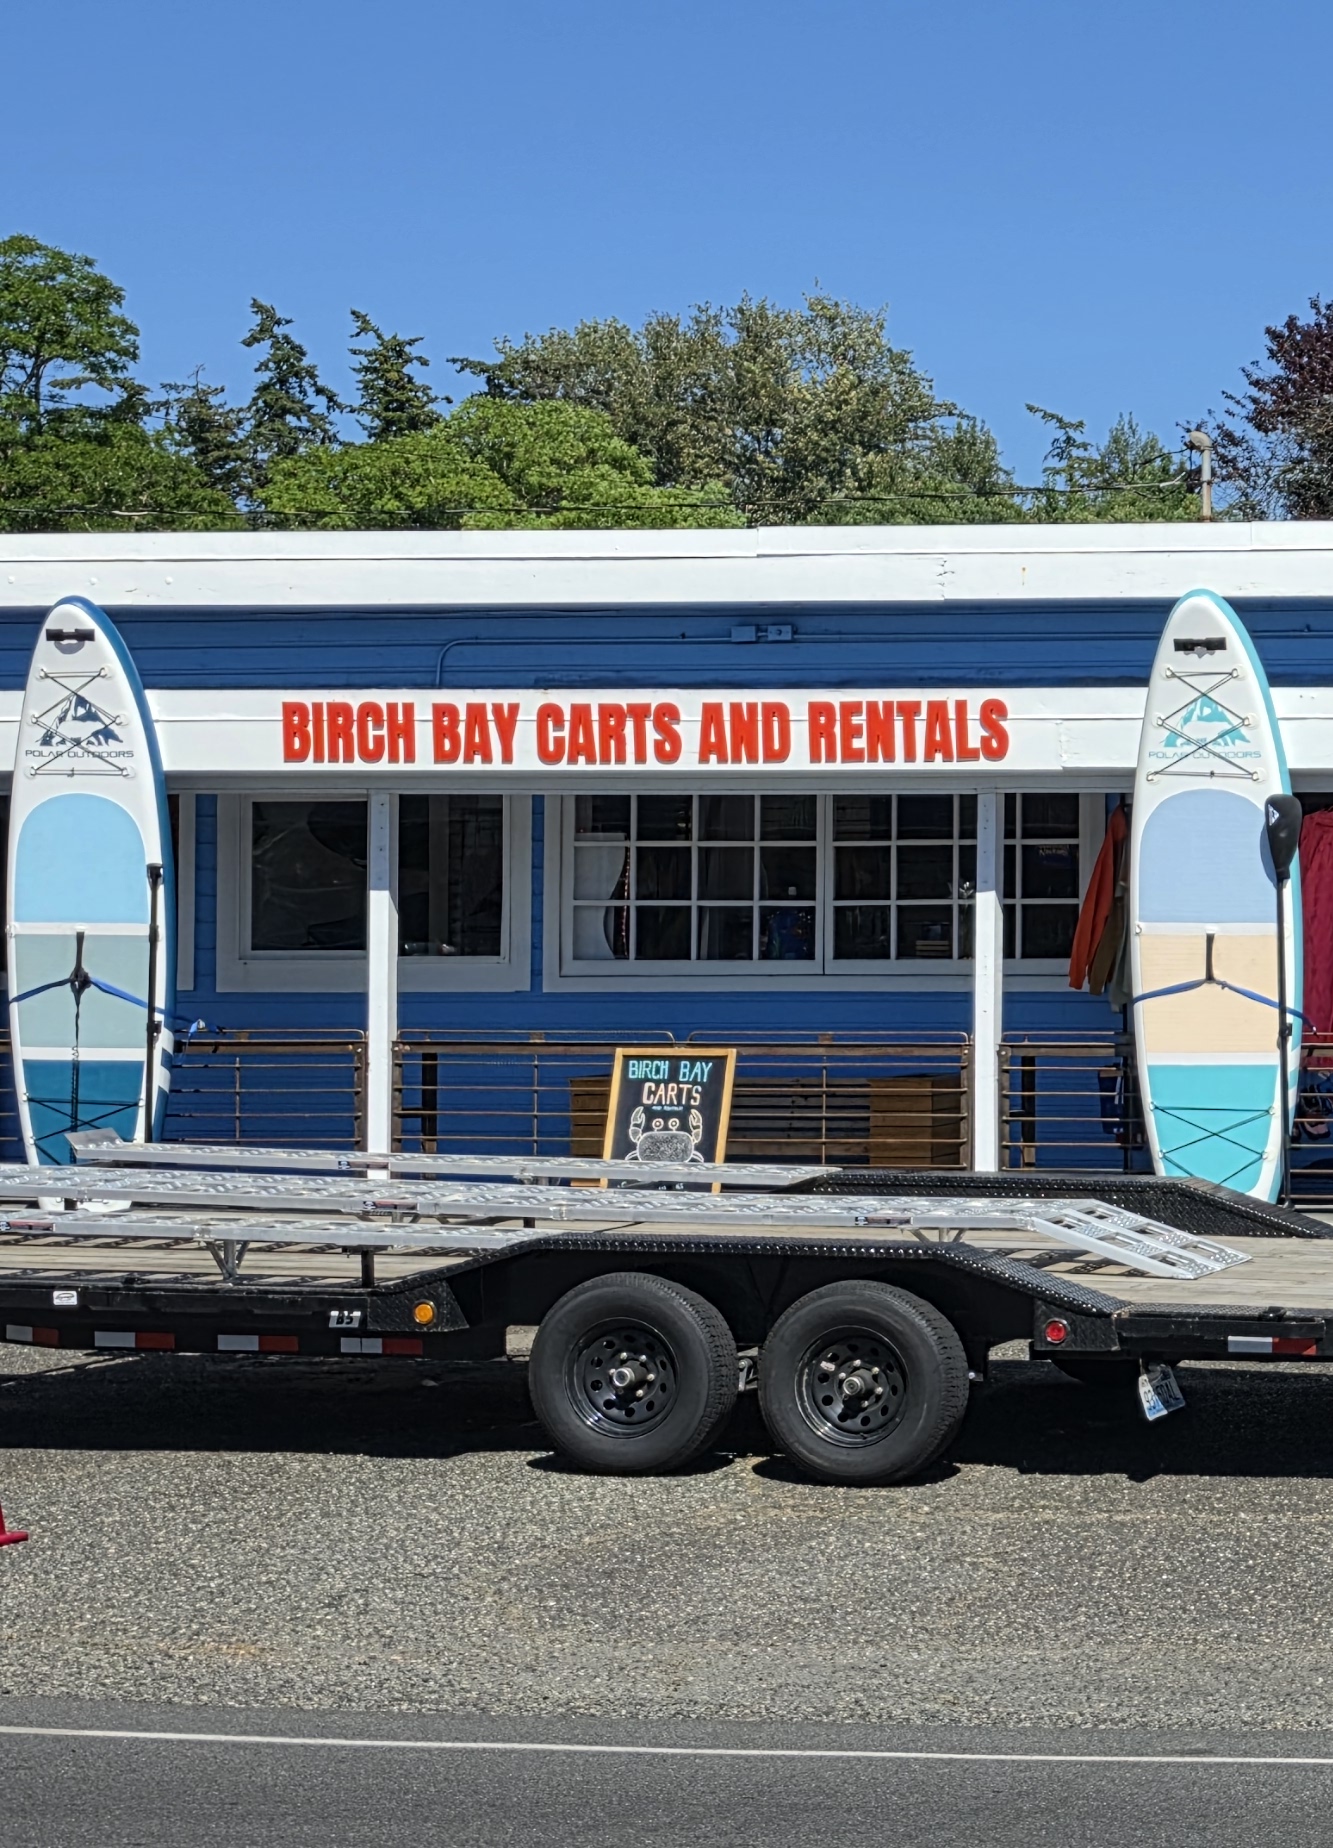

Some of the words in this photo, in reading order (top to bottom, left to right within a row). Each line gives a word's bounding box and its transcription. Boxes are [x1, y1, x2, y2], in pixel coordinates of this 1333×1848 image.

[282, 701, 416, 764] BIRCH
[432, 702, 520, 765] BAY
[536, 702, 682, 765] CARTS
[698, 701, 791, 765] AND
[808, 698, 1010, 764] RENTALS
[25, 749, 63, 758] POLAR
[67, 750, 134, 759] OUTDOORS
[628, 1060, 669, 1080] BIRCH
[679, 1061, 713, 1082] BAY
[642, 1082, 702, 1106] CARTS
